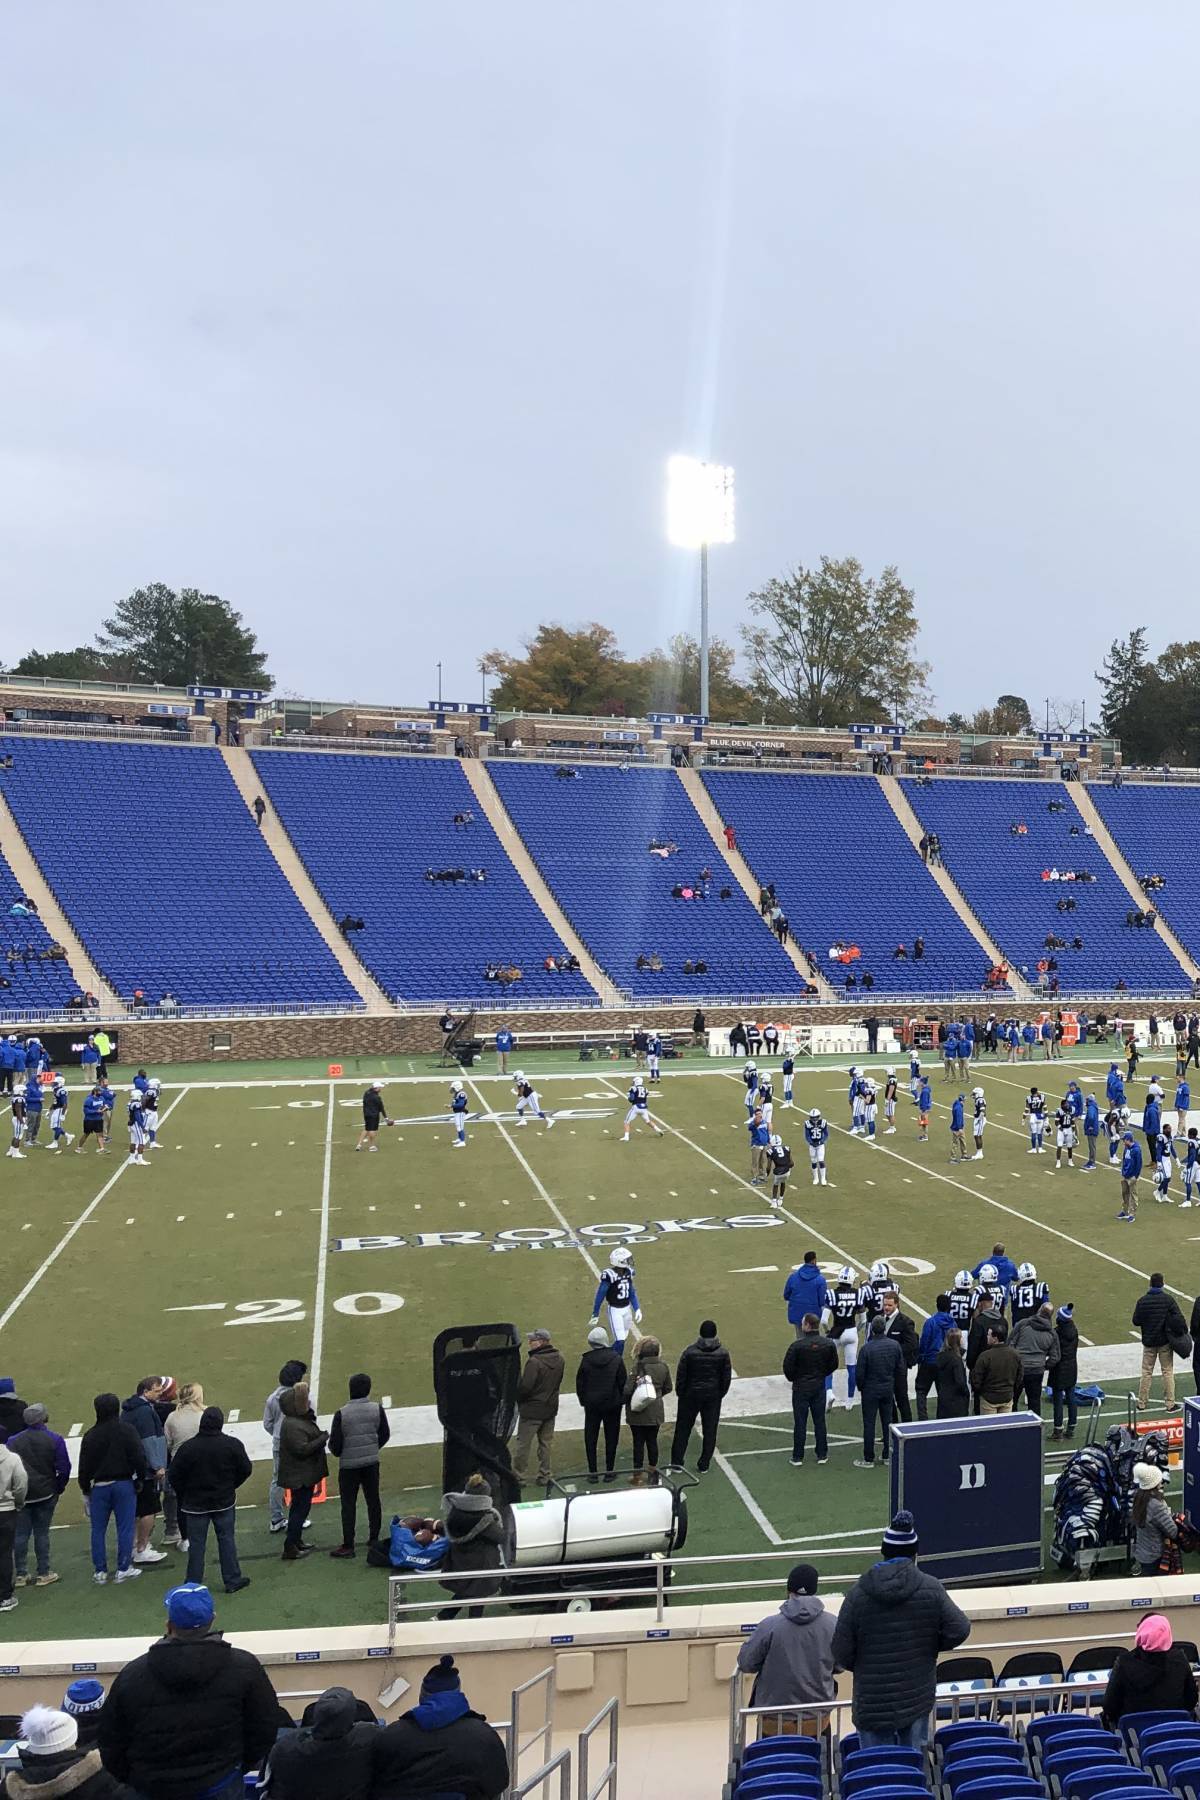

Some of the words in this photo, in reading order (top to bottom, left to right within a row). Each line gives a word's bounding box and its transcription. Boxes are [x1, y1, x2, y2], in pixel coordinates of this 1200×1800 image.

[756, 741, 785, 749] CORNER
[42, 1073, 53, 1082] 10
[330, 1066, 341, 1075] 20
[1032, 1099, 1042, 1109] 27
[811, 1129, 822, 1139] 35
[776, 1147, 785, 1157] 9
[329, 1214, 786, 1253] BROOKS
[489, 1235, 659, 1252] FIELD
[617, 1283, 630, 1299] 31
[1018, 1289, 1034, 1307] 13
[221, 1291, 405, 1326] 20
[837, 1301, 856, 1318] 37
[950, 1303, 969, 1320] 26
[959, 1463, 987, 1490] D
